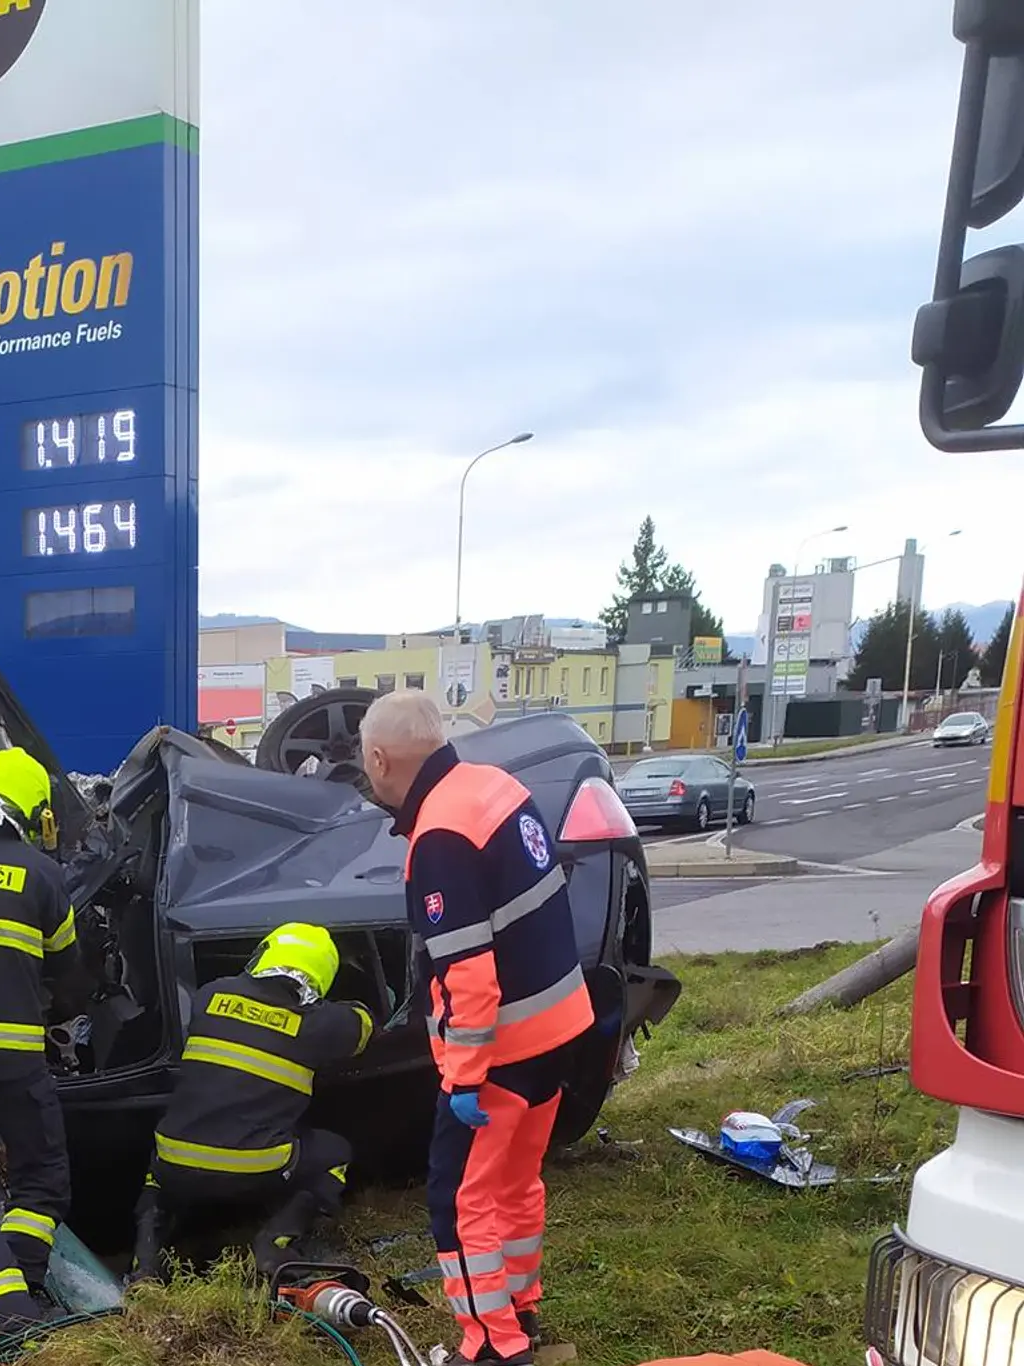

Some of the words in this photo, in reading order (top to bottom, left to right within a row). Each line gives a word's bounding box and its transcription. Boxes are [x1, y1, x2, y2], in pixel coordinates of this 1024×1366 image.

[75, 320, 122, 344] Fuels
[36, 410, 136, 468] 1.419
[38, 502, 136, 556] 1.464
